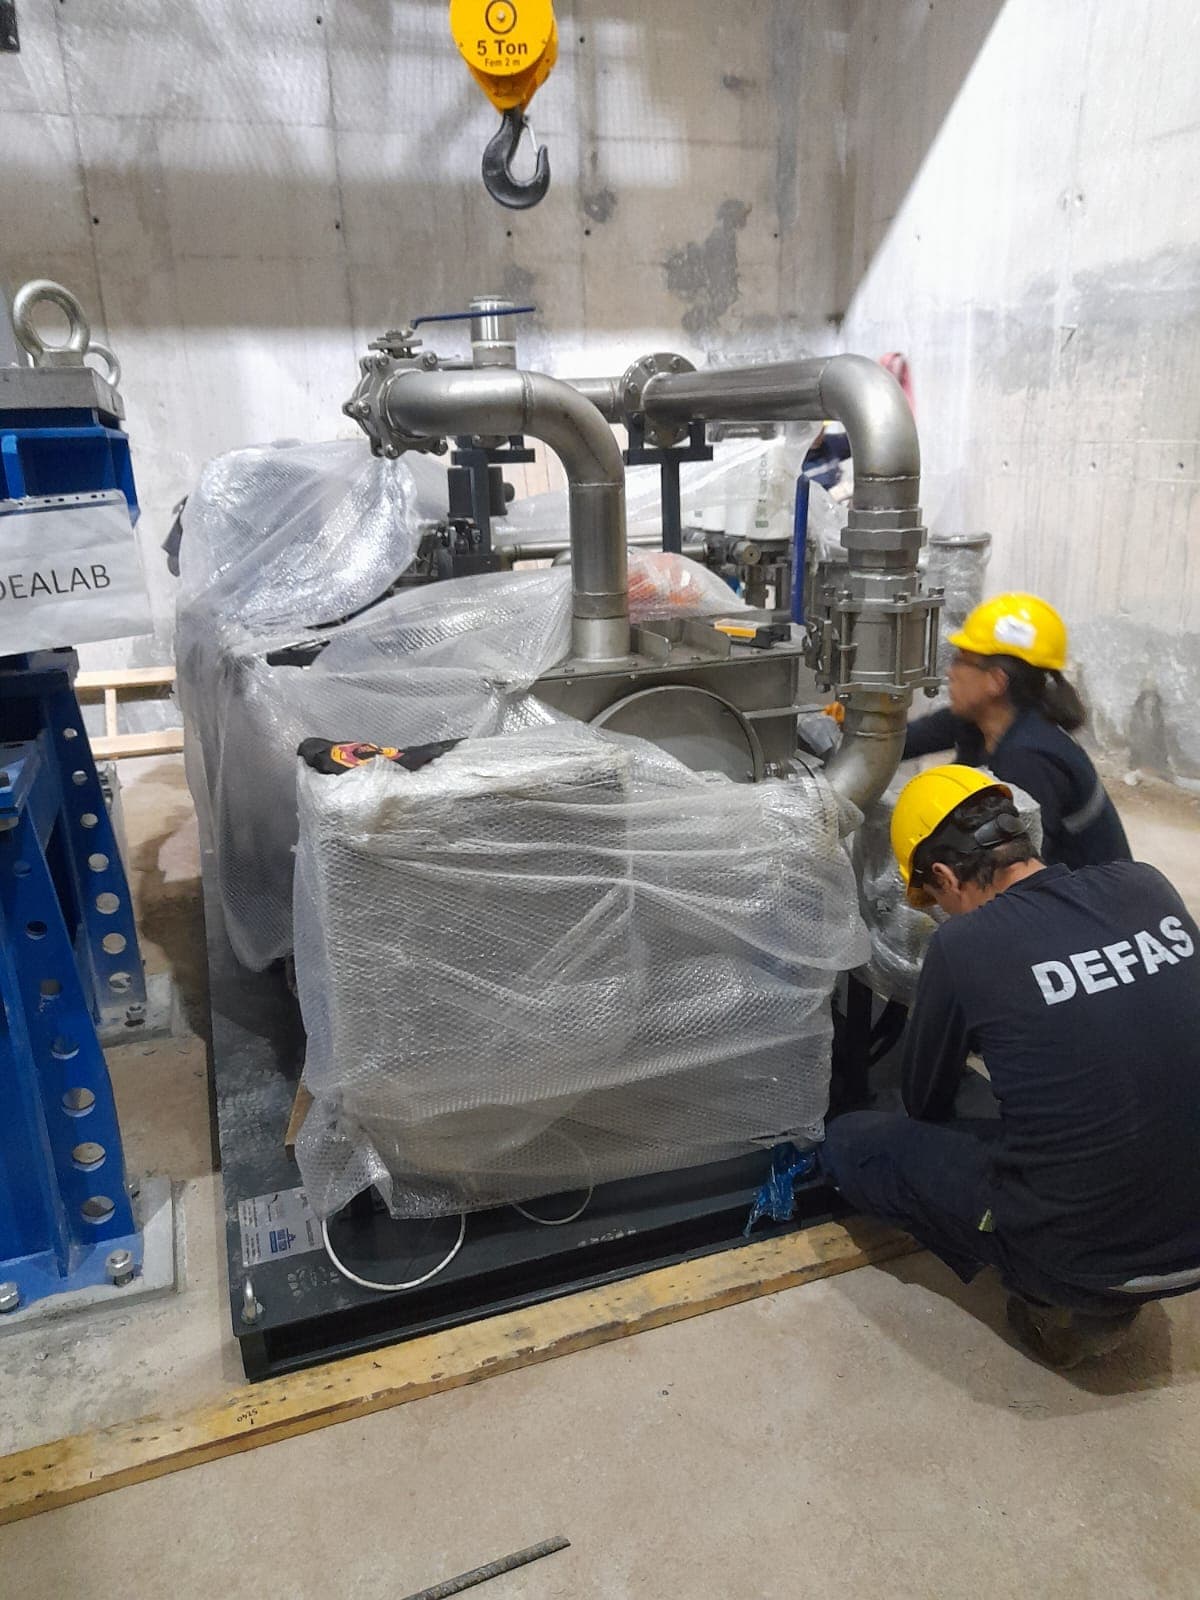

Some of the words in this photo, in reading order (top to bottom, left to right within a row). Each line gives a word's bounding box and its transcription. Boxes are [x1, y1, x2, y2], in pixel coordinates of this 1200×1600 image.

[476, 40, 487, 56] 5
[494, 39, 528, 55] Ton
[505, 57, 510, 66] 2
[1031, 915, 1194, 1006] DEFAS
